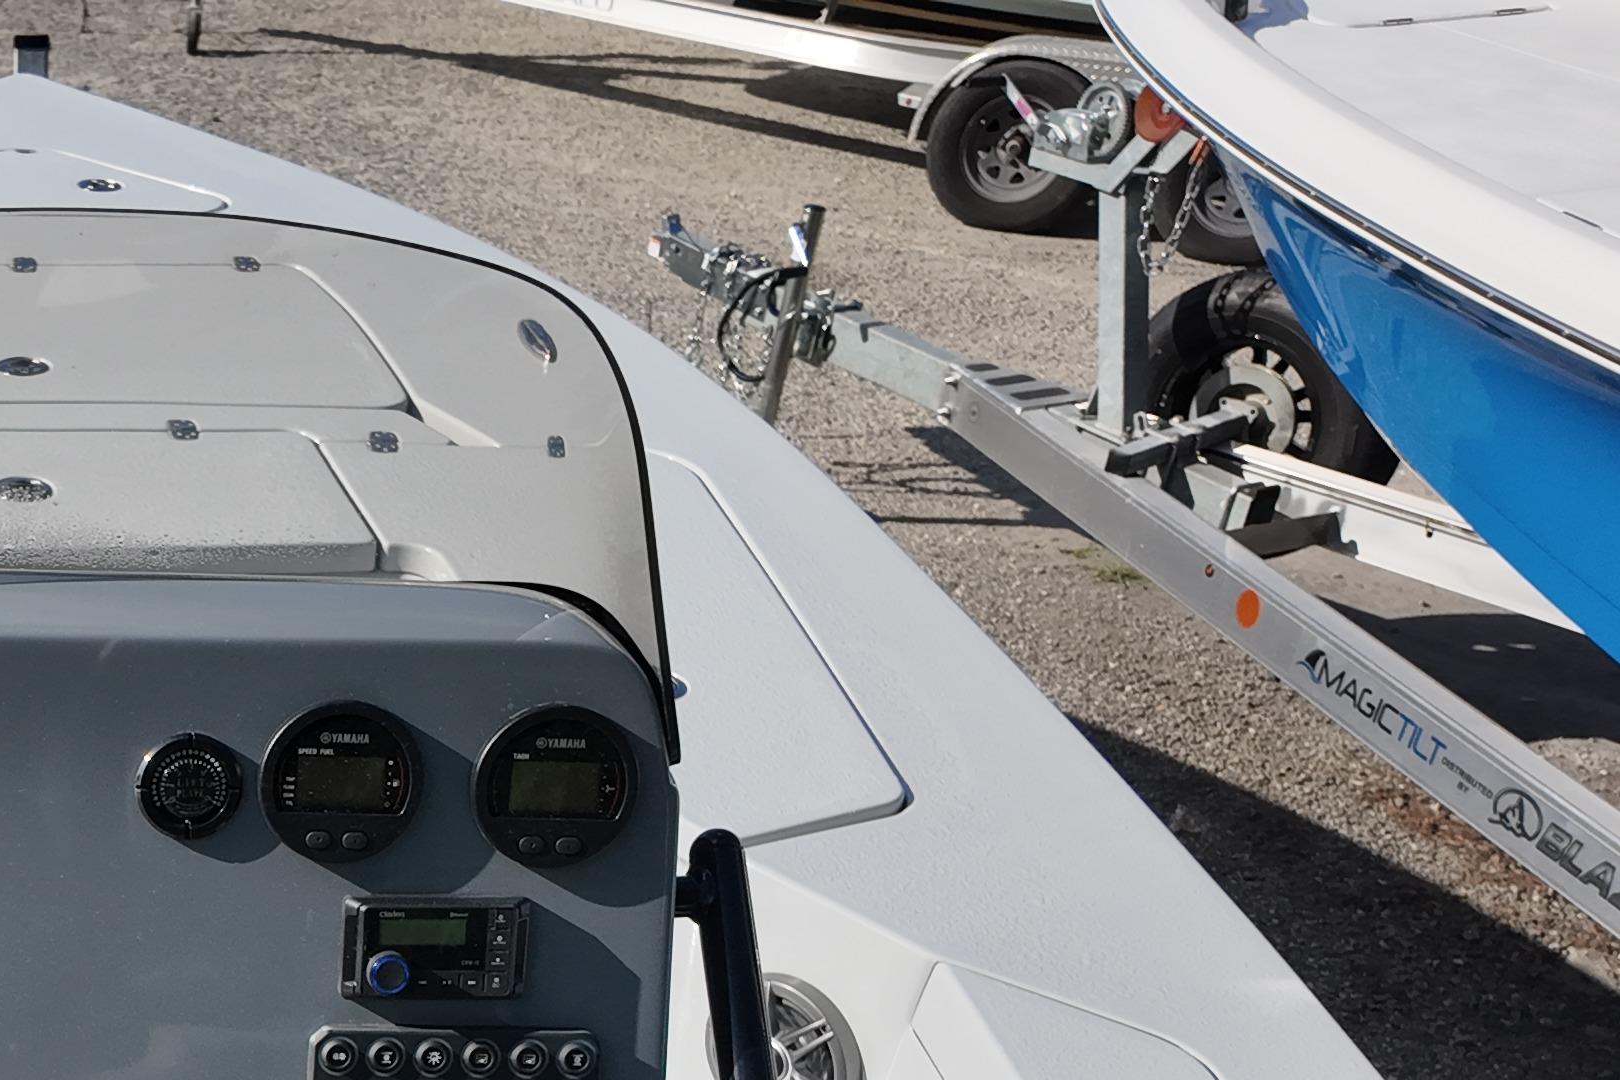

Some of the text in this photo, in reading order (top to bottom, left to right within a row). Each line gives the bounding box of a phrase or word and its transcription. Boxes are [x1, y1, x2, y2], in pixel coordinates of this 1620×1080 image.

[1317, 657, 1447, 765] MAGICTILT
[331, 733, 370, 744] YAMAHA
[547, 738, 586, 749] YAMAHA
[1441, 757, 1494, 800] DISTRIBUTED
